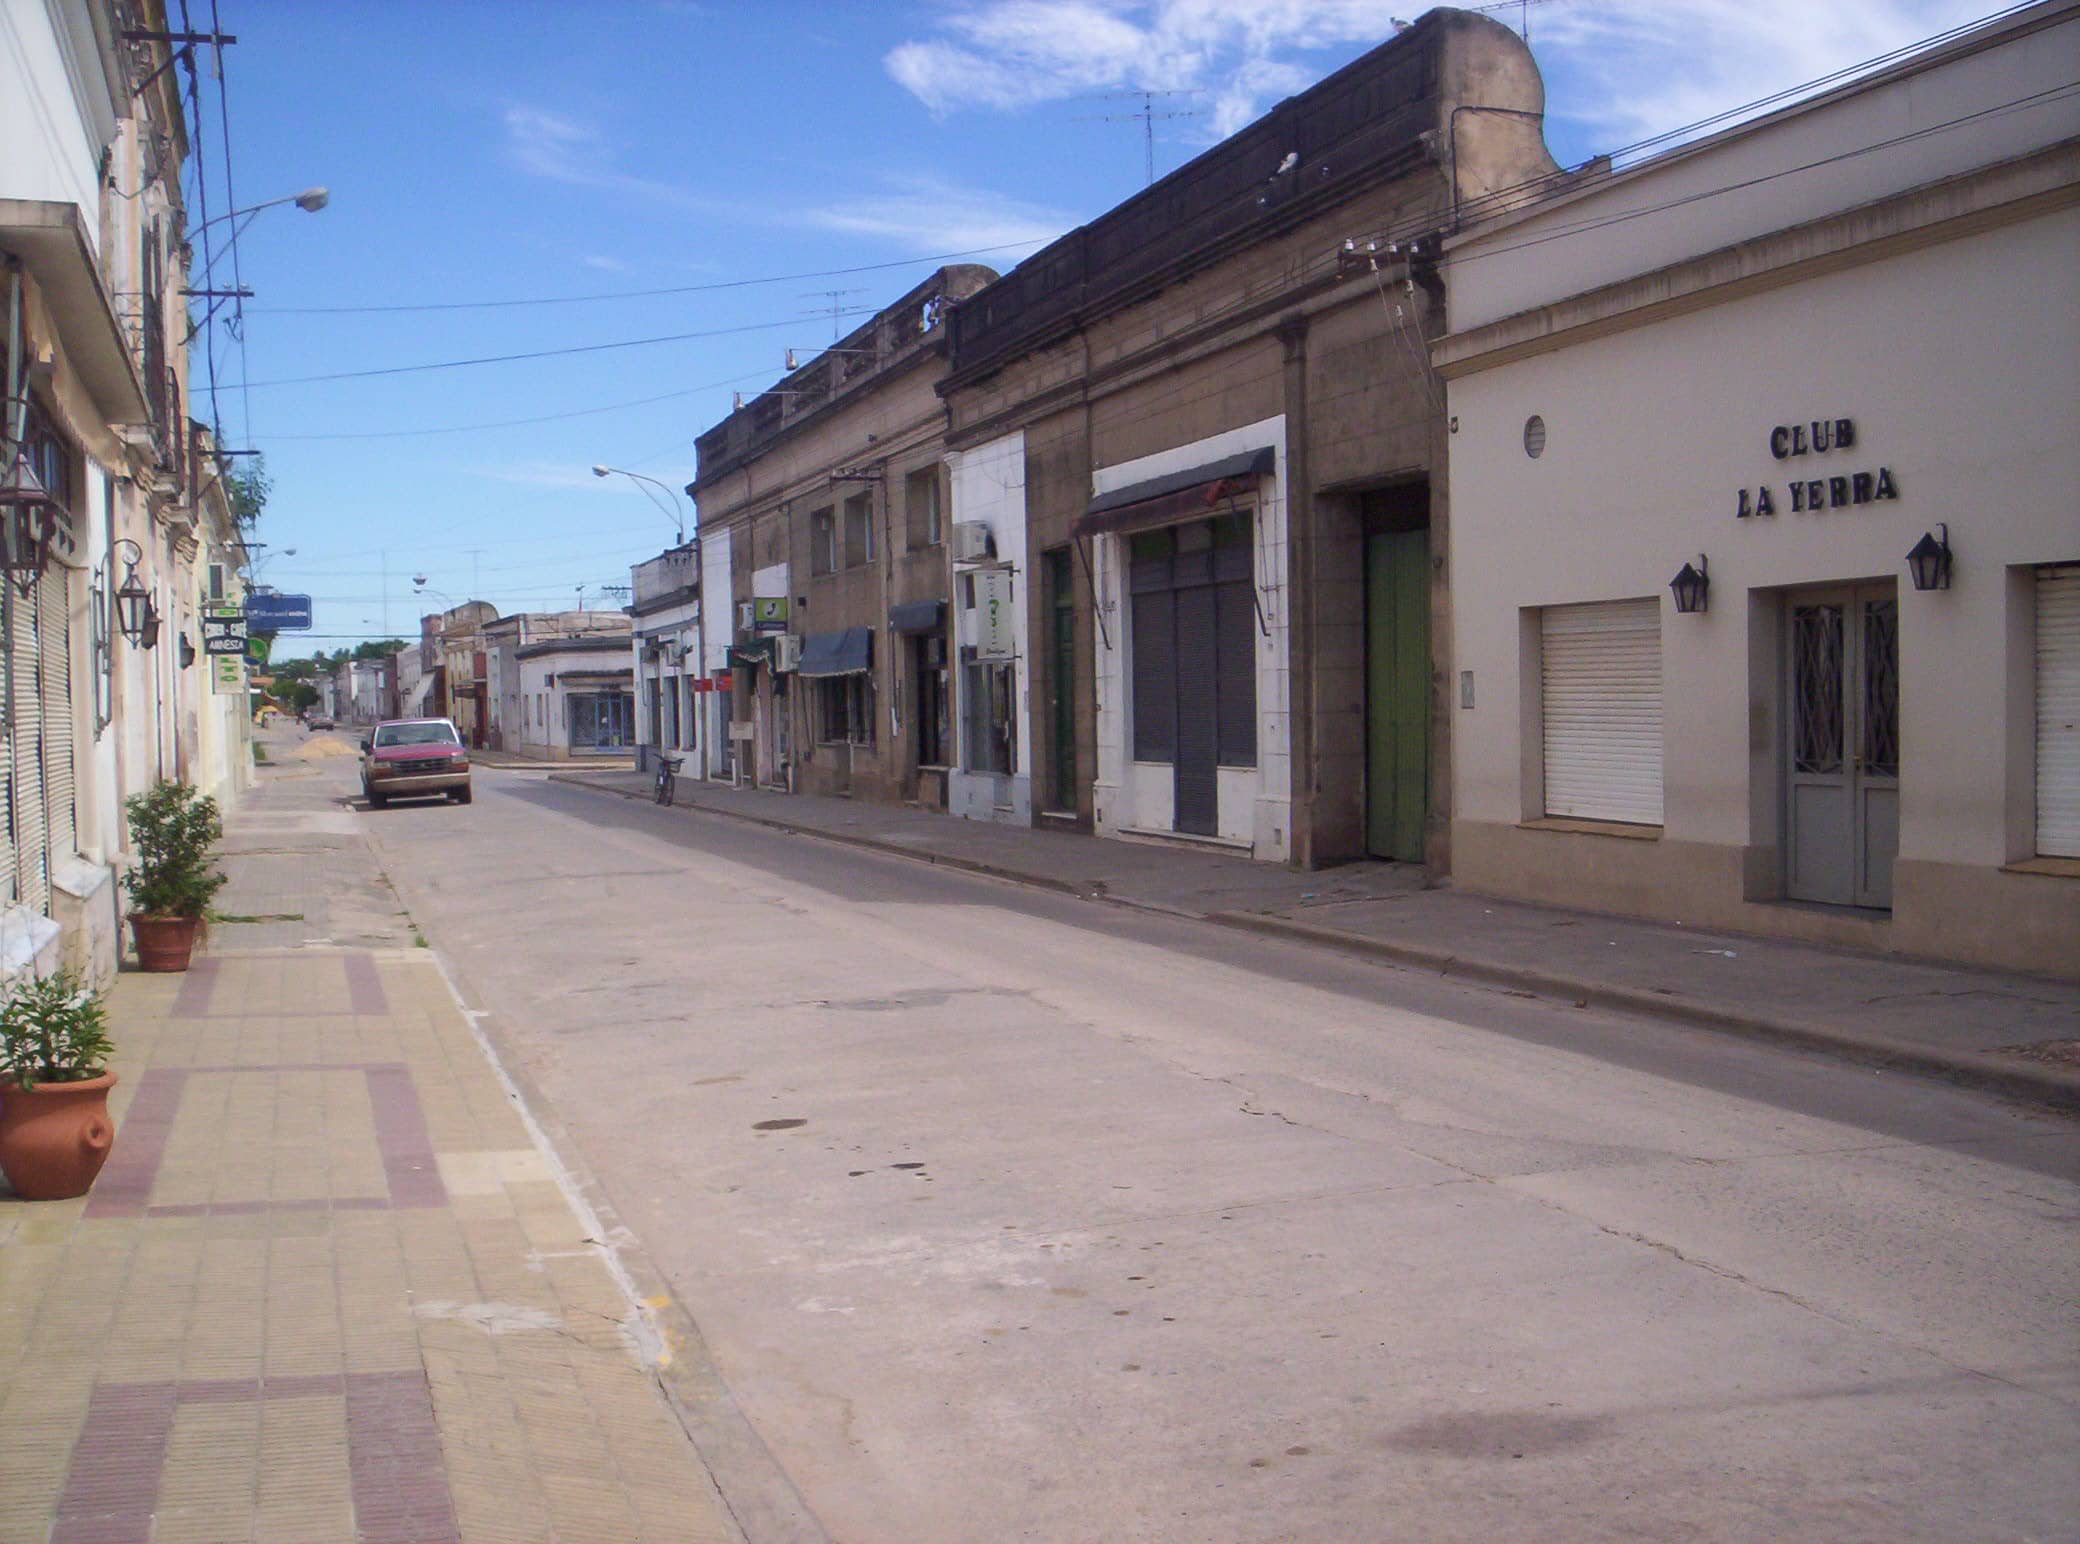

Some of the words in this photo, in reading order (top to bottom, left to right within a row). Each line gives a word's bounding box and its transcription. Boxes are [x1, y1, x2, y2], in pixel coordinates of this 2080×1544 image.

[1770, 418, 1855, 459] CLUB
[1736, 486, 1774, 518] LA
[1788, 467, 1898, 513] YERRA
